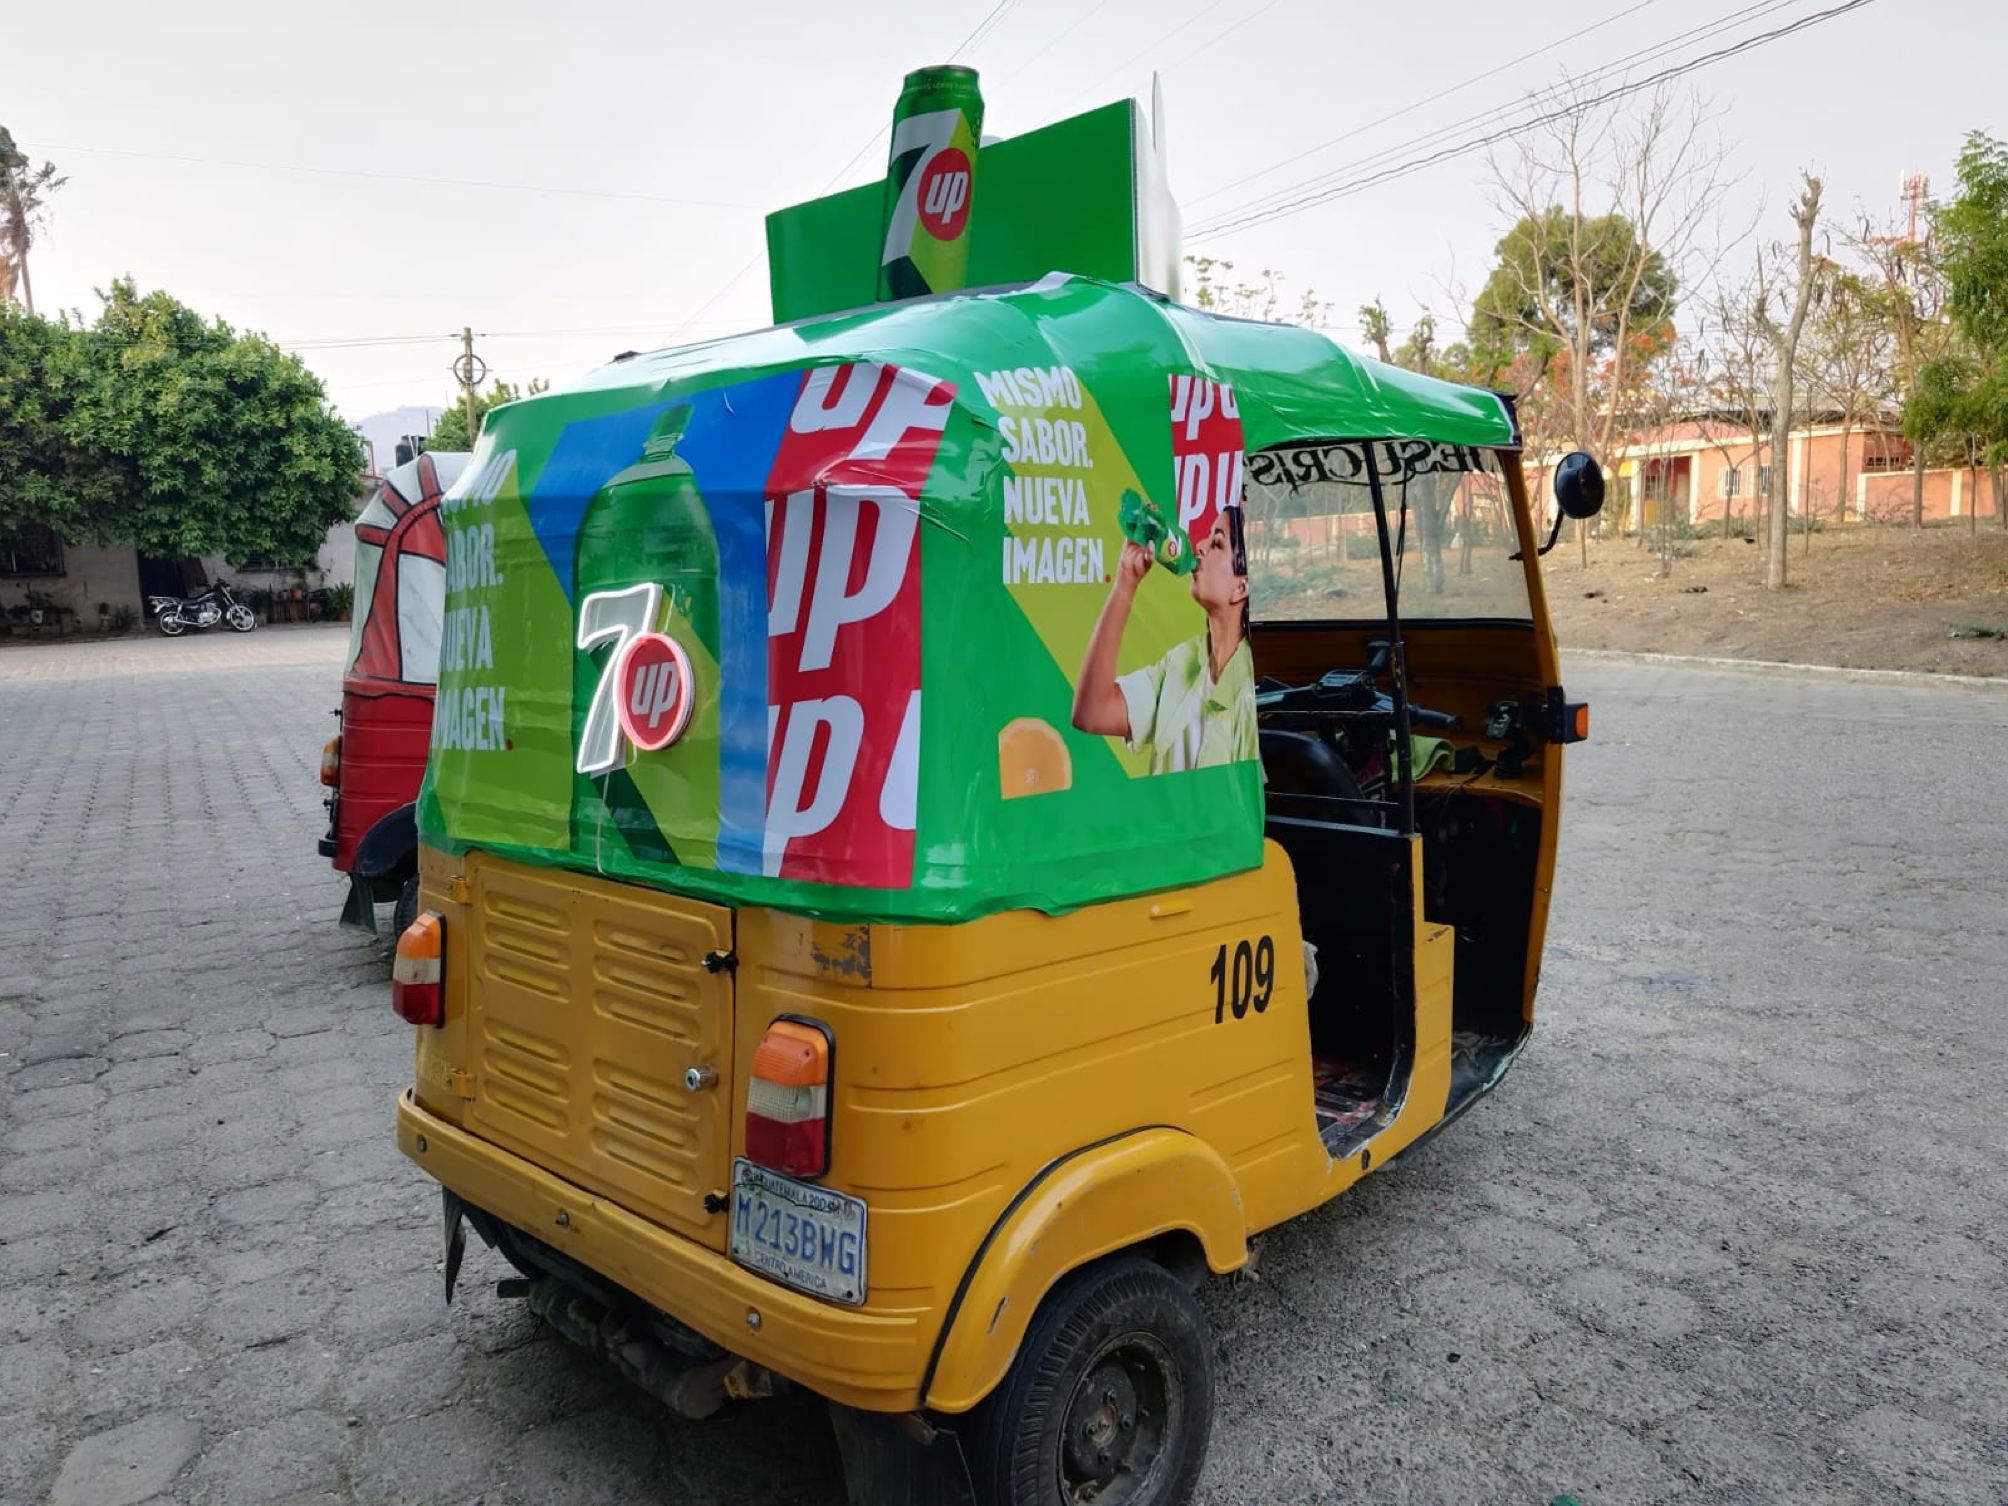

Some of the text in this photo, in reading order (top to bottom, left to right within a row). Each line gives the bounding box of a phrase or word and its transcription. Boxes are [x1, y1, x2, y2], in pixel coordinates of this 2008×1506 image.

[974, 366, 1083, 410] MISMO
[998, 416, 1093, 468] SABOR.
[1003, 476, 1090, 525] NUEVA
[446, 523, 504, 592] ABOR.
[1003, 537, 1112, 584] IMAGEN.
[432, 686, 513, 751] MAGEN.
[1210, 935, 1275, 1024] 109
